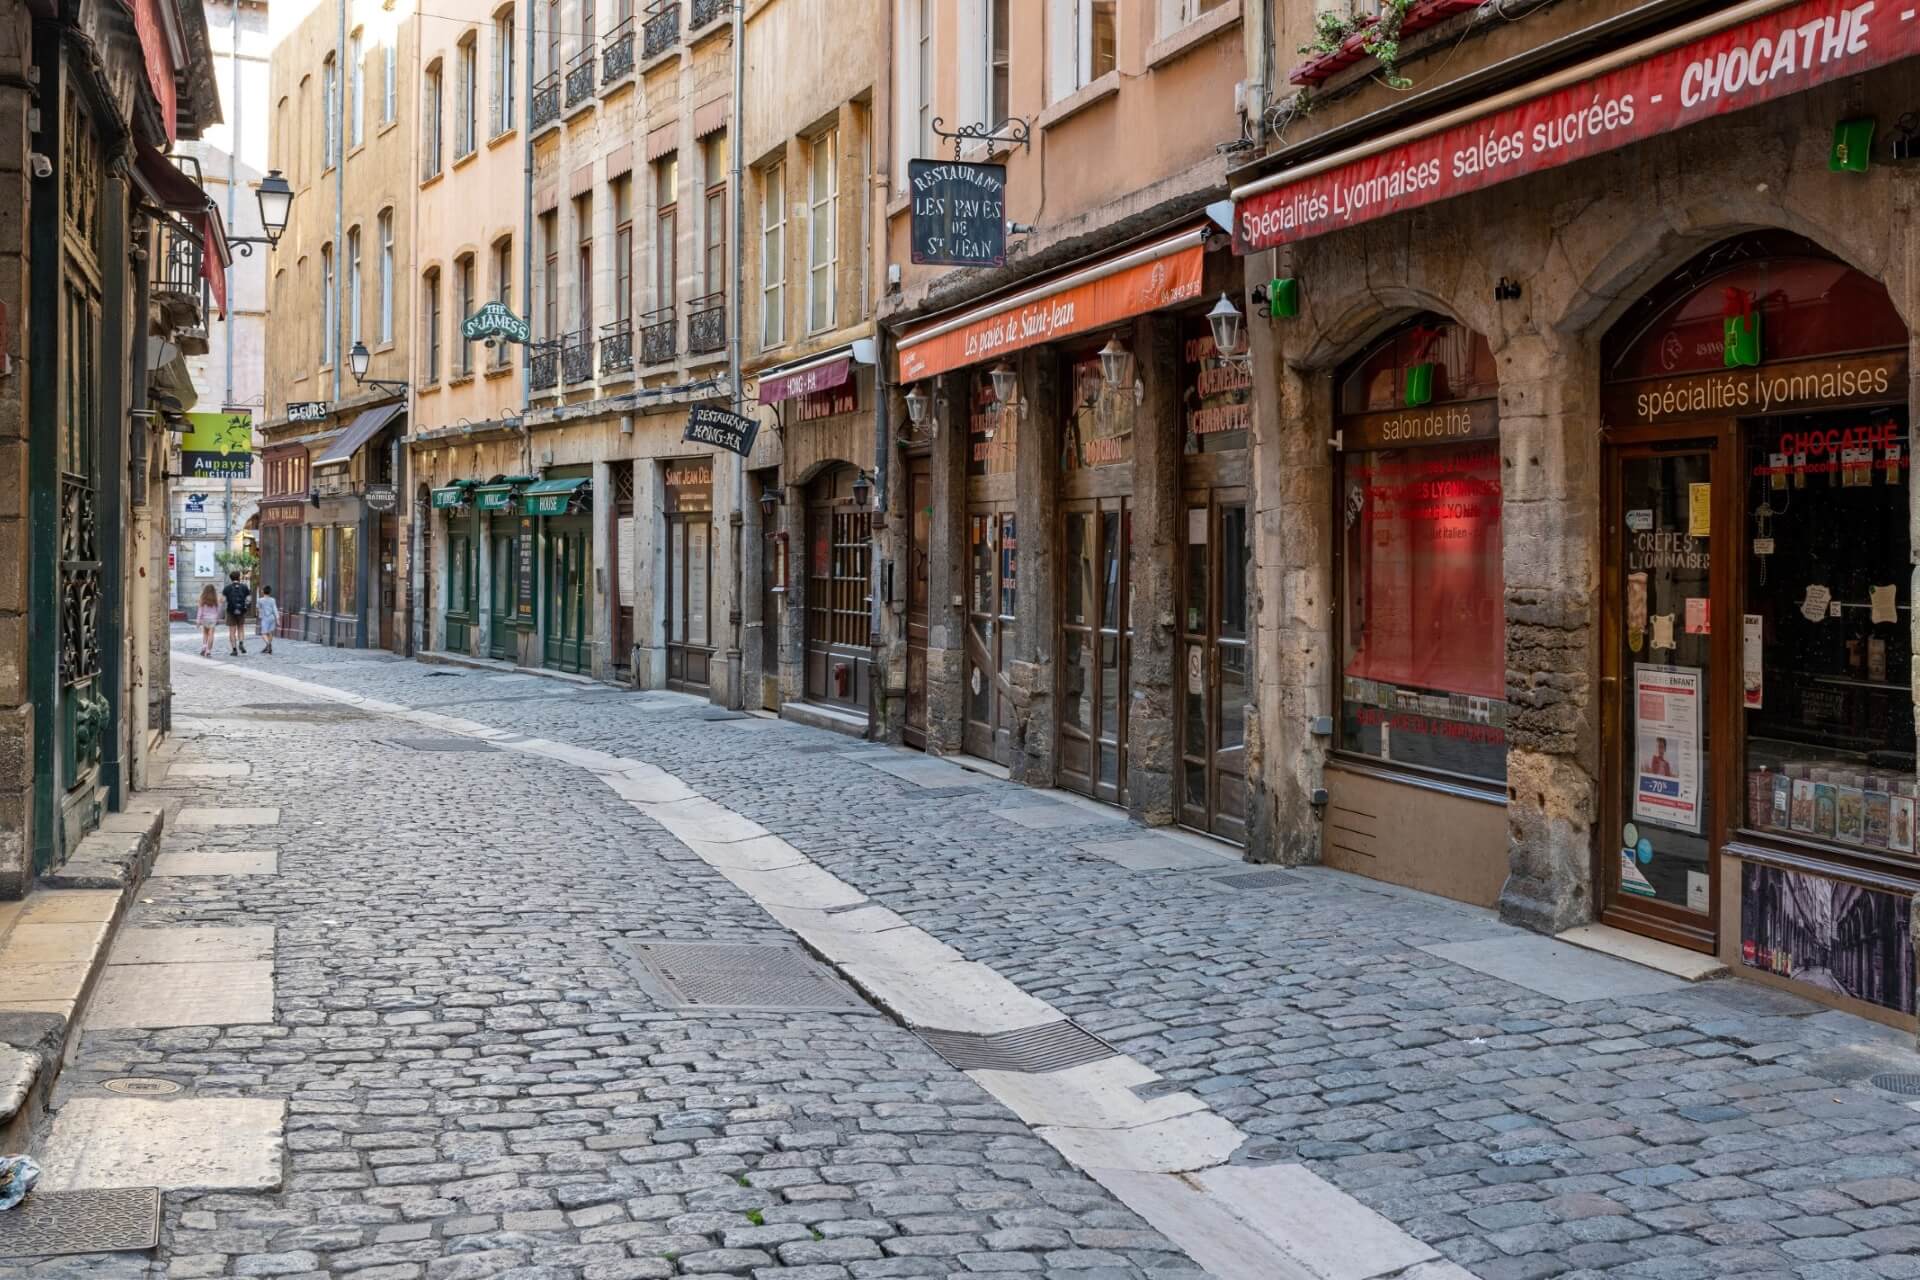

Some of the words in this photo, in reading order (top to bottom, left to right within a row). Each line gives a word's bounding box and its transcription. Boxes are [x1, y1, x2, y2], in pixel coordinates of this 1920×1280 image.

[1242, 190, 1328, 246] Spécialités
[1333, 156, 1440, 220] Lyonnaises
[1453, 128, 1524, 178] salées
[1532, 94, 1634, 152] sucrées
[1680, 1, 1874, 108] CHOCATHE
[914, 165, 1001, 193] RESTAURANT
[916, 197, 945, 216] LES
[952, 221, 967, 236] DE
[950, 239, 992, 258] JEAN
[486, 304, 506, 315] THE
[964, 330, 978, 356] Les
[979, 320, 1004, 356] pavés
[1005, 315, 1017, 342] de
[1019, 299, 1075, 337] Saint-Jean
[1637, 376, 1749, 424] spécialités
[1755, 364, 1888, 412] lyonnaises
[697, 409, 749, 433] RESTAURANT
[1383, 414, 1421, 442] salon
[1424, 412, 1443, 438] de
[1446, 408, 1471, 434] thé
[1780, 421, 1898, 456] CHOCATHÉ
[666, 467, 682, 486] SAINT
[682, 466, 698, 485] JEAN
[539, 496, 557, 512] HOUSE
[1638, 527, 1693, 553] CRÊPES
[1669, 676, 1695, 689] ENFANT
